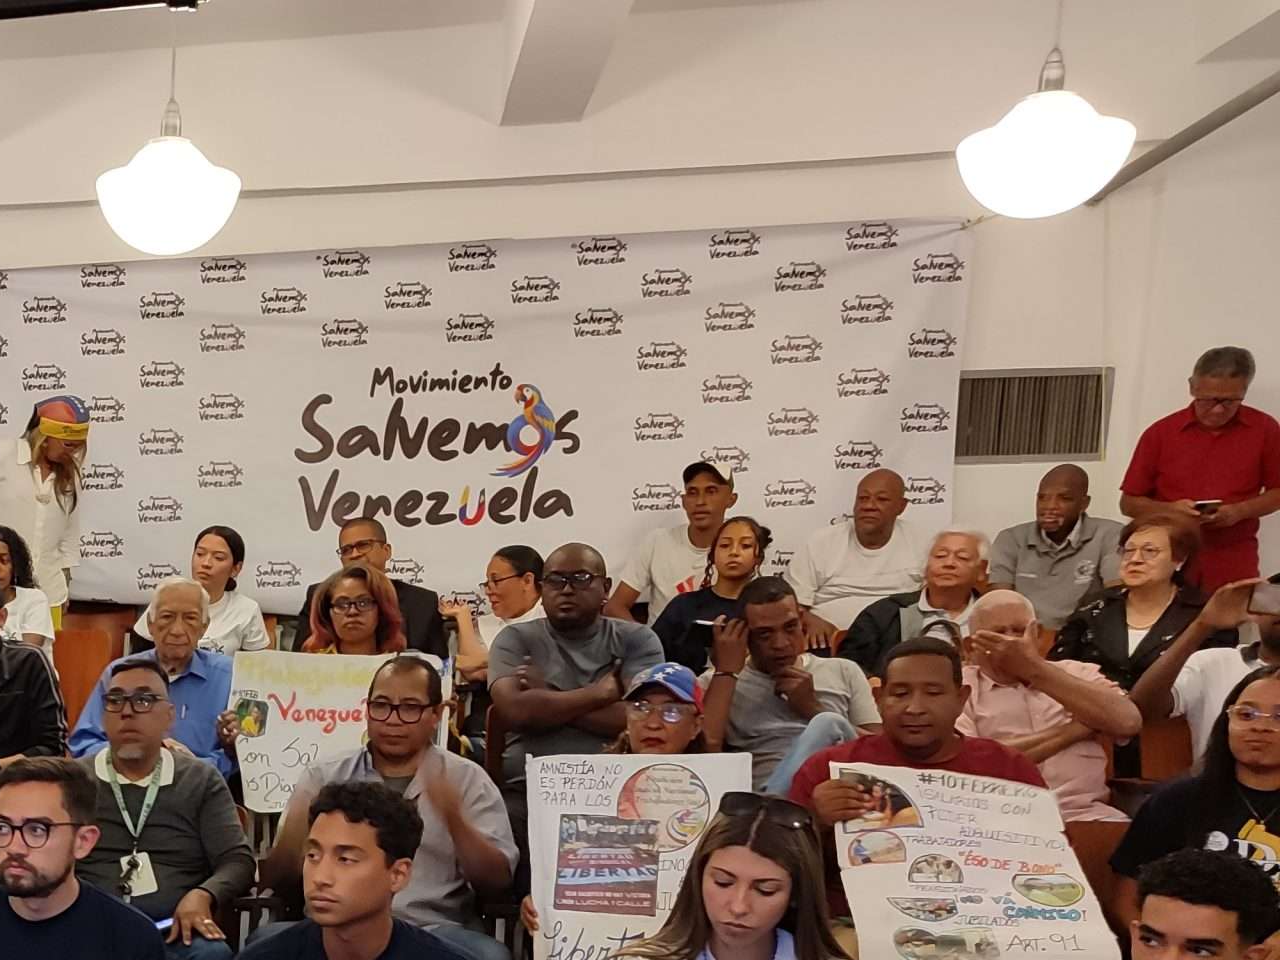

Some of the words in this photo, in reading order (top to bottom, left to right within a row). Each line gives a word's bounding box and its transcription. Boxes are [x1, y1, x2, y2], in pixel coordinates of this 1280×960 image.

[369, 363, 513, 398] Movimiento
[293, 391, 581, 467] Salvemos
[297, 466, 574, 532] Venezuela
[267, 691, 368, 735] Venezue
[605, 763, 623, 776] NO
[1001, 802, 1033, 815] CON
[991, 858, 1013, 871] DE
